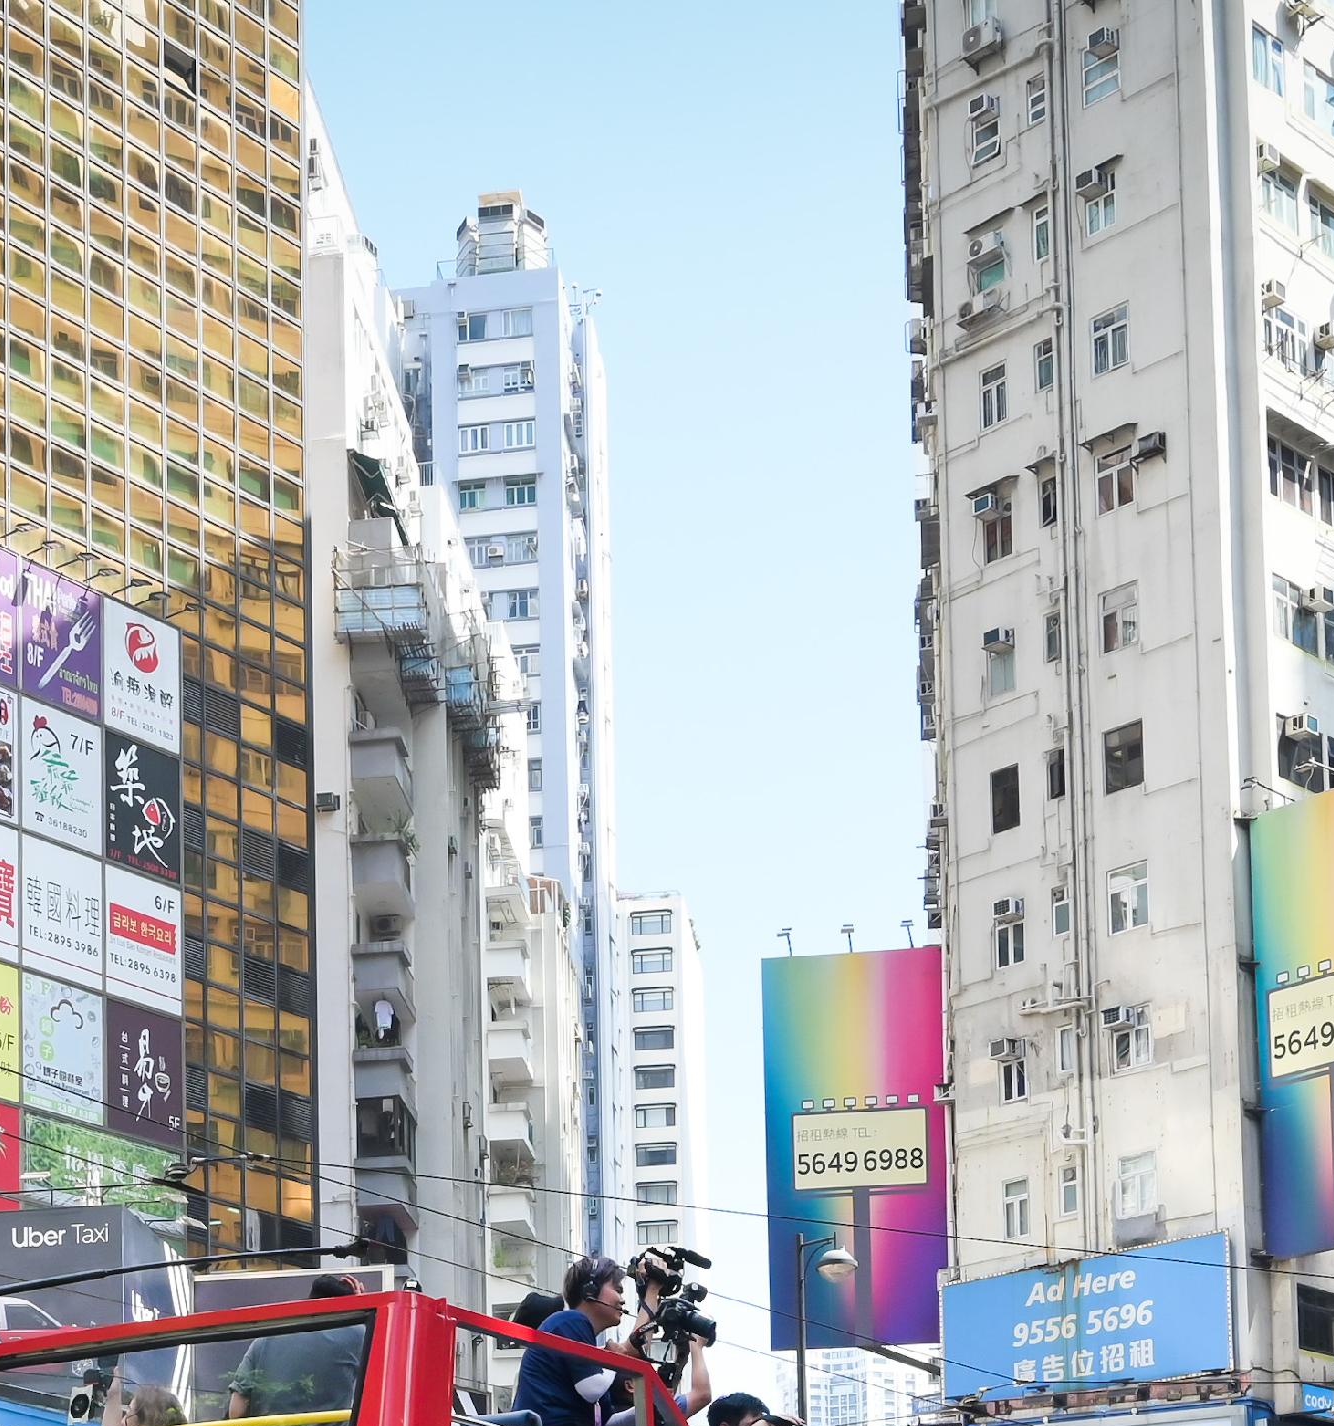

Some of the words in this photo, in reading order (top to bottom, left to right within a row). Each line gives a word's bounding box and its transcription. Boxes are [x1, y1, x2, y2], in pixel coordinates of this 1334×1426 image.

[27, 642, 45, 668] 8/F
[70, 734, 94, 756] 7/F
[26, 875, 101, 938] 韓國料理
[154, 895, 175, 914] 6/F
[74, 939, 99, 957] 3986
[153, 965, 177, 984] 6398
[1272, 995, 1325, 1023] 招租熱線
[1273, 1021, 1334, 1060] 5649
[796, 1124, 848, 1143] 招租熱線
[797, 1151, 858, 1176] 5649
[864, 1147, 925, 1173] 6988
[12, 1226, 67, 1249] Uber
[71, 1223, 110, 1245] Taxi
[1025, 1279, 1065, 1308] Ad
[1071, 1267, 1137, 1299] Here
[1011, 1313, 1077, 1348] 9556
[1085, 1299, 1154, 1335] 5696
[1012, 1338, 1155, 1382] 廣告位招租
